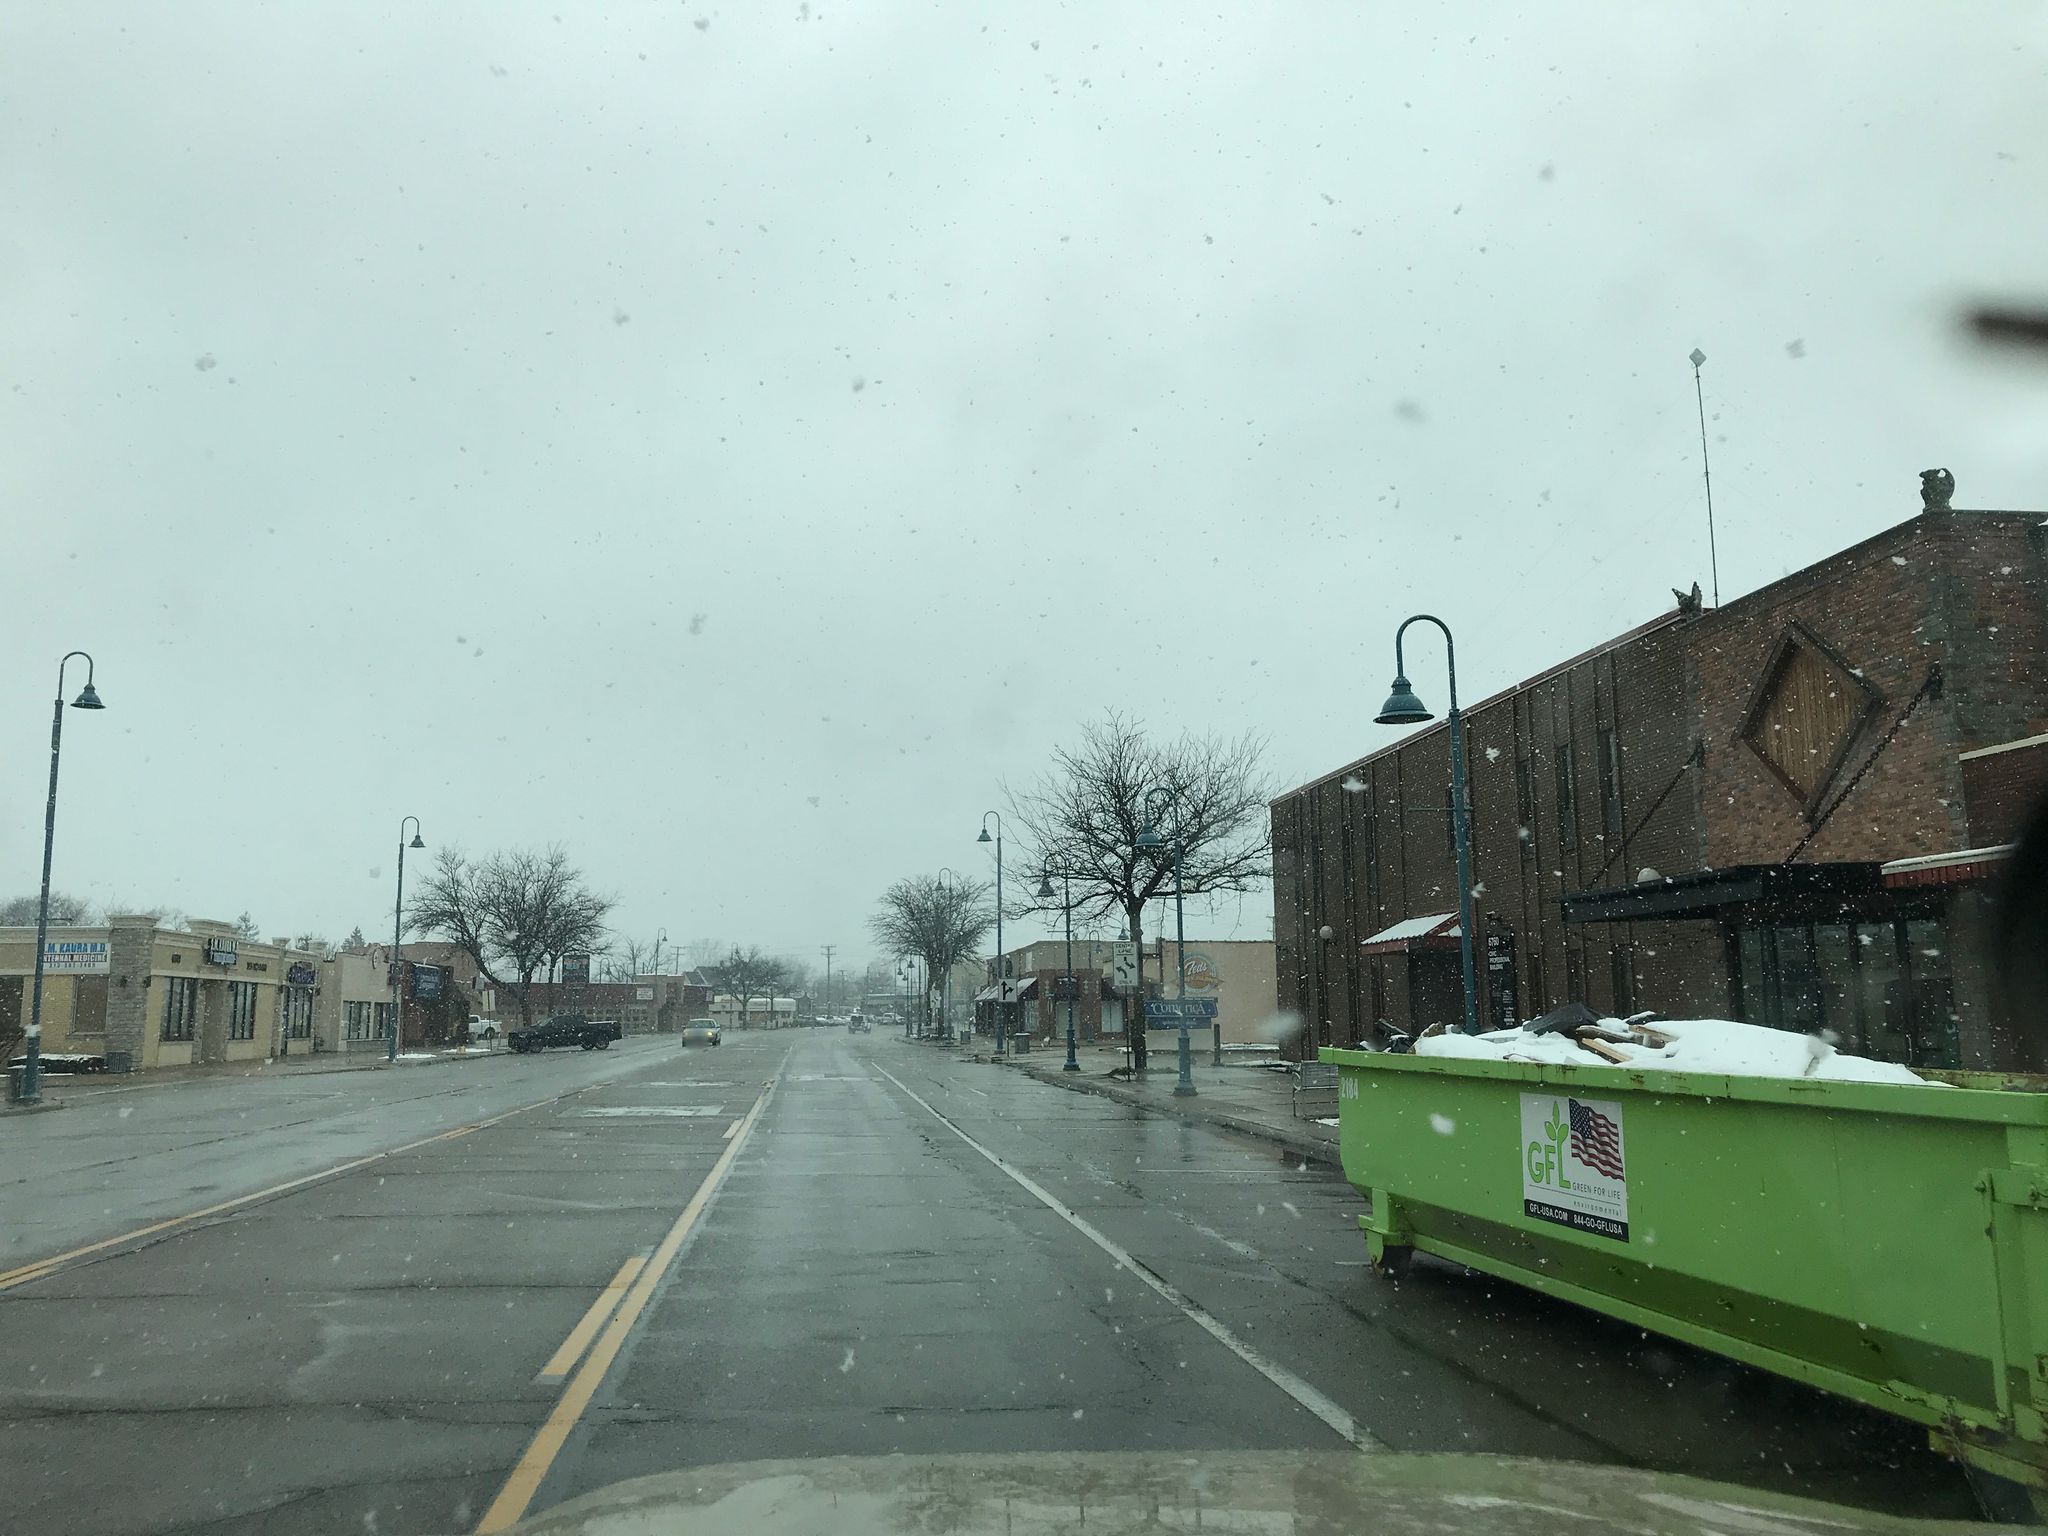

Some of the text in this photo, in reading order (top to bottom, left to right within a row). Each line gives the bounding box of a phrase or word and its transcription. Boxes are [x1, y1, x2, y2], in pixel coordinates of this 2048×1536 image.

[43, 954, 107, 963] NTERNAL MEDICINE
[1527, 1120, 1571, 1189] GFL
[1572, 1182, 1621, 1200] GREEN FOR LIFE
[1573, 1200, 1622, 1217] environmental
[1529, 1203, 1623, 1235] GFL-USA.COM 844-GO-GFLUSA
